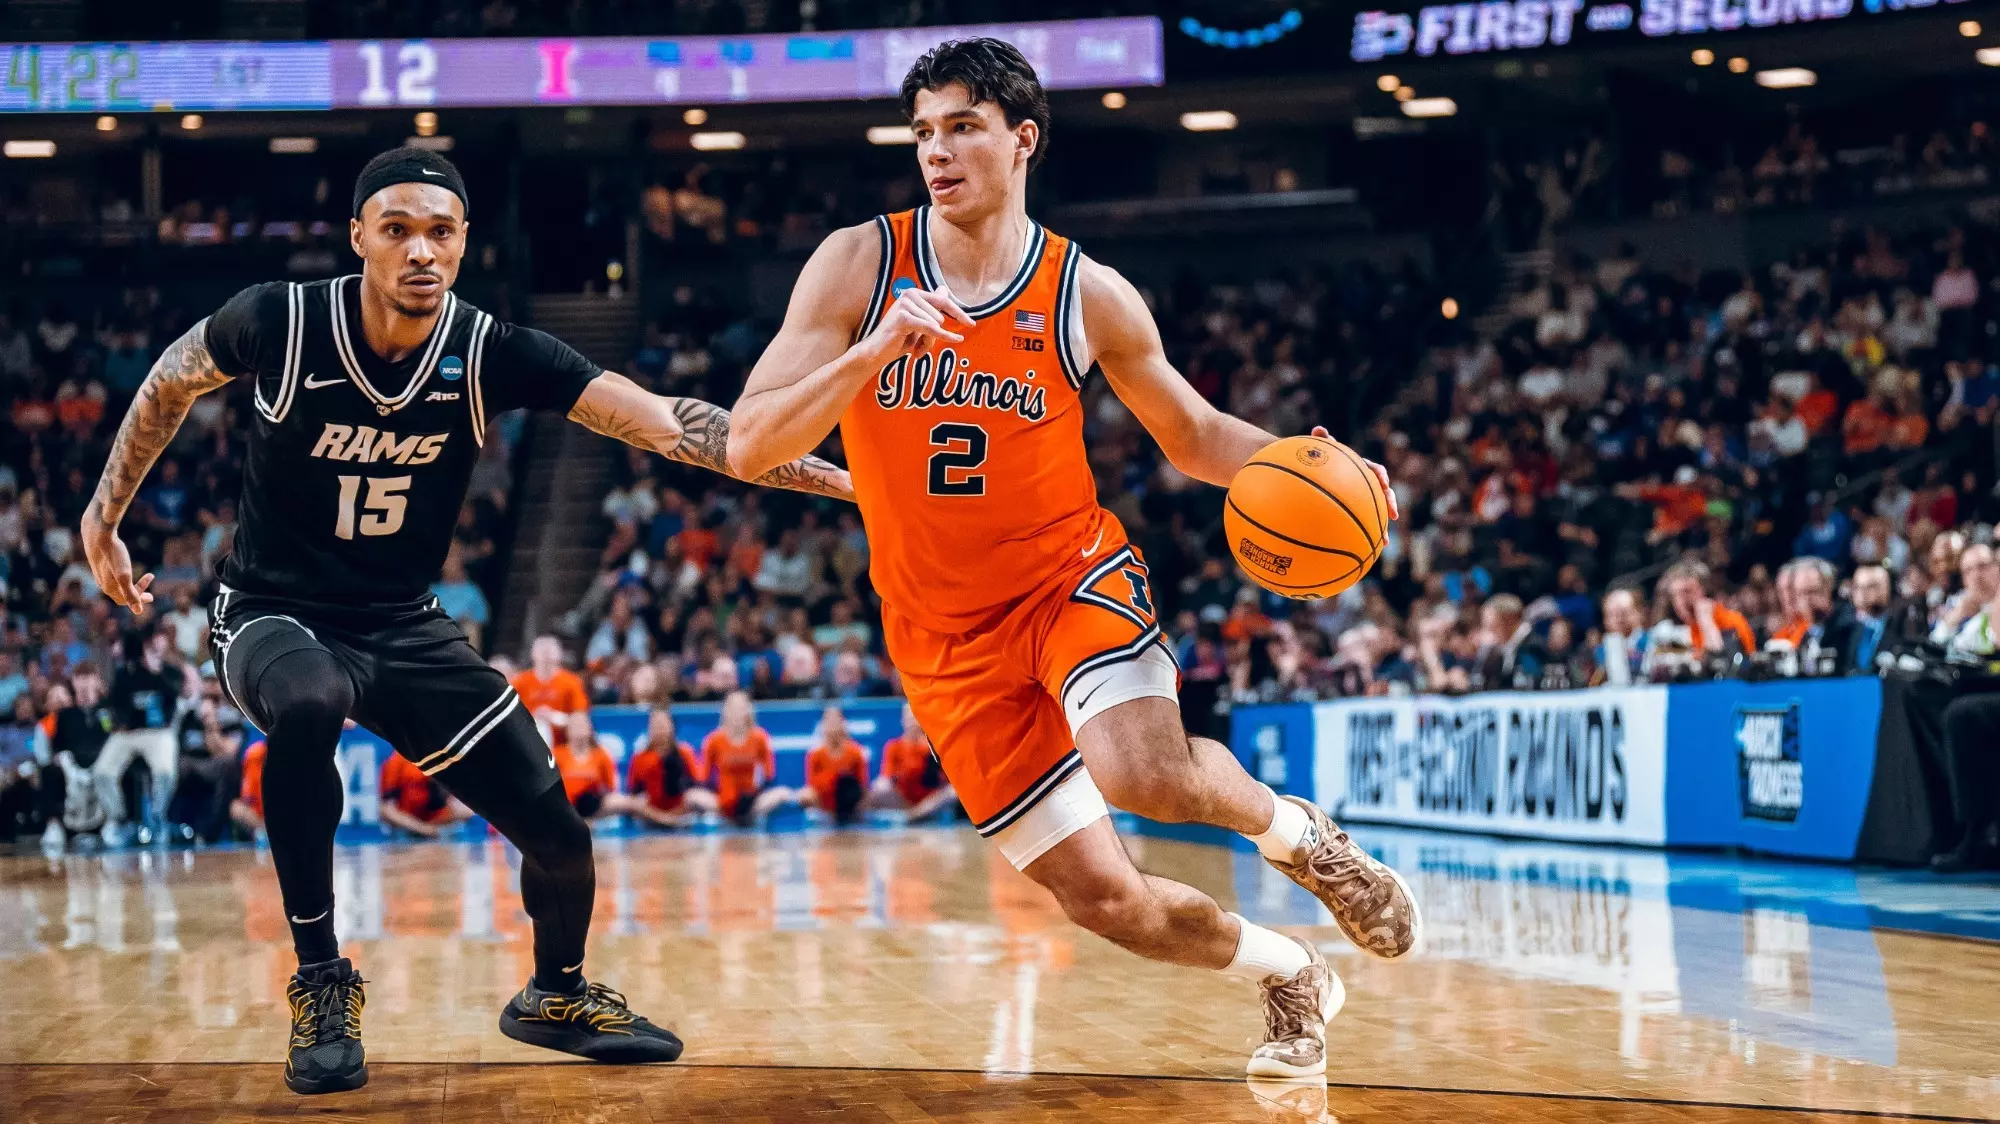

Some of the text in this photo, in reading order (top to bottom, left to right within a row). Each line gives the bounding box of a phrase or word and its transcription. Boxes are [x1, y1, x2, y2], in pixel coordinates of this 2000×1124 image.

[1416, 0, 1584, 56] FIRST
[359, 40, 437, 104] 12
[425, 391, 460, 402] A10
[442, 367, 463, 375] NCAA
[875, 348, 1047, 422] Illinois
[310, 423, 450, 465] RAMS
[926, 421, 989, 497] 2
[335, 475, 412, 540] 15
[1250, 554, 1278, 573] MARCH
[1120, 567, 1154, 619] I
